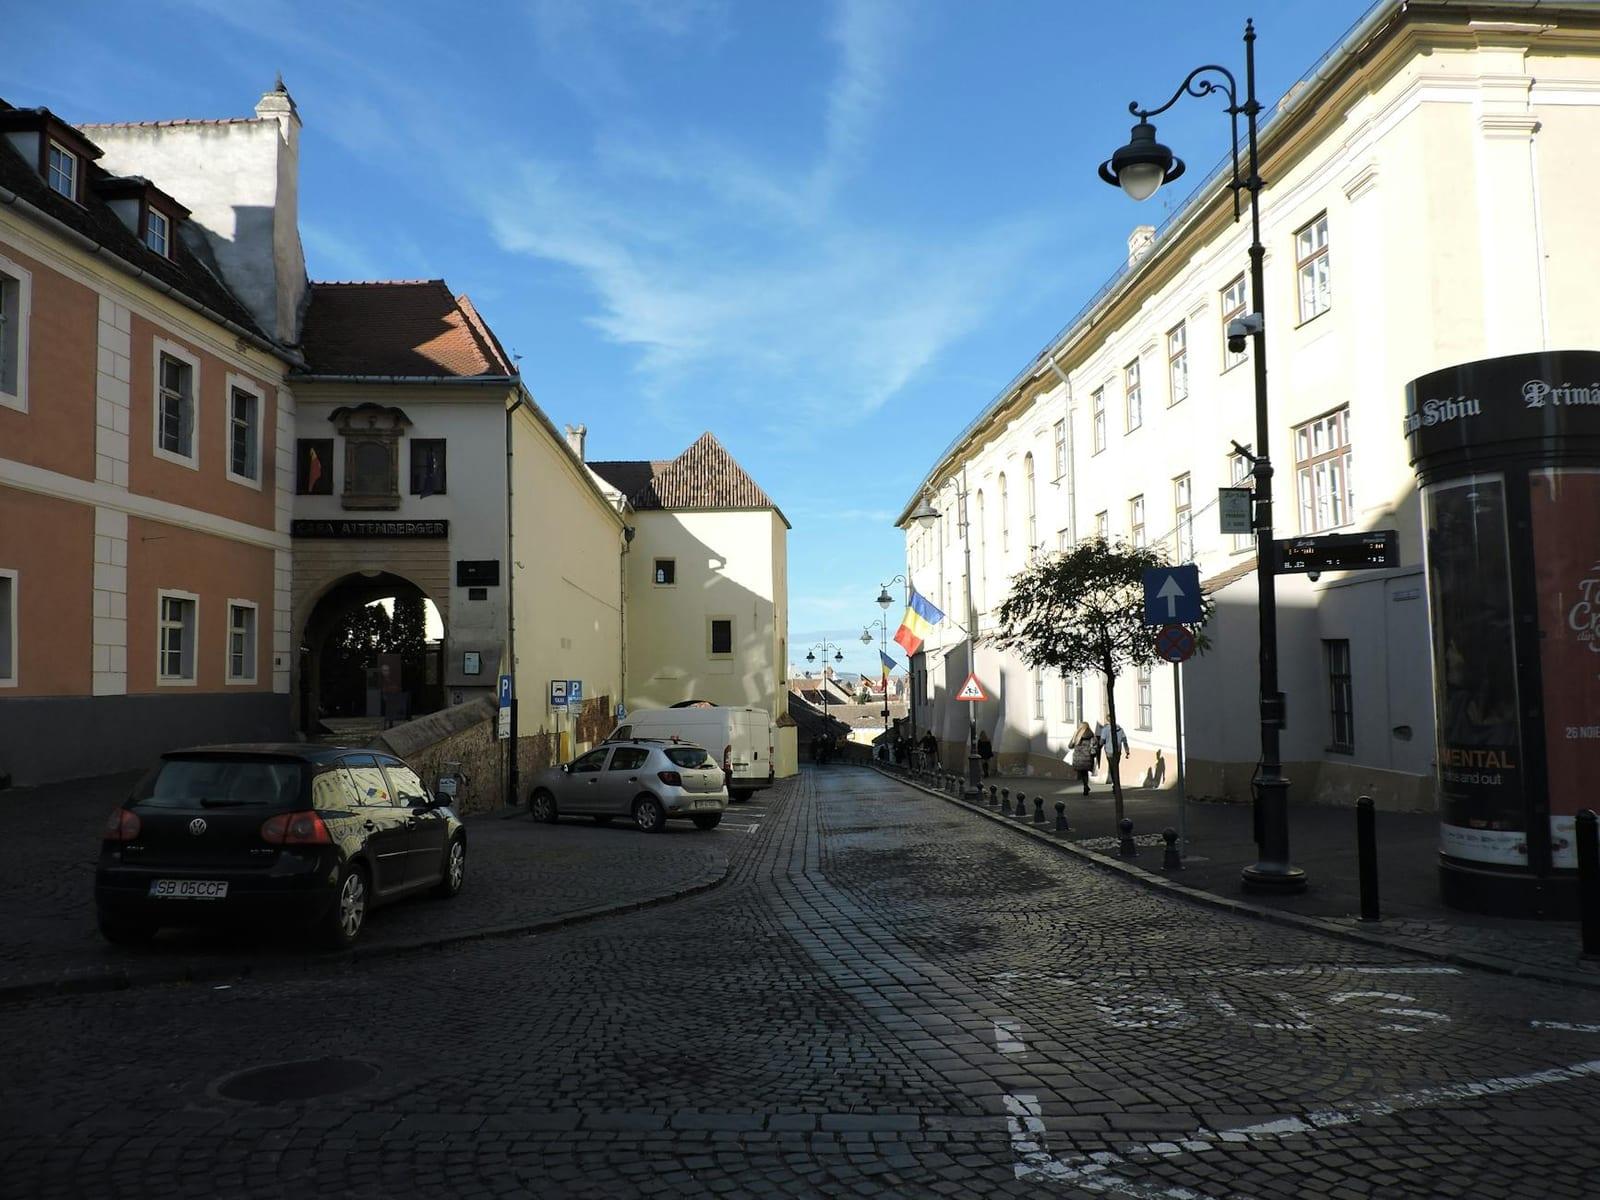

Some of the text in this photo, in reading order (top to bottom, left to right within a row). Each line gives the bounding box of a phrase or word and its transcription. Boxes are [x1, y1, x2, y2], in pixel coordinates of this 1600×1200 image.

[1422, 395, 1482, 427] Sibiu
[502, 679, 509, 698] P
[572, 682, 579, 695] P
[1566, 726, 1578, 738] 26
[1481, 774, 1502, 785] out
[158, 881, 176, 895] SB
